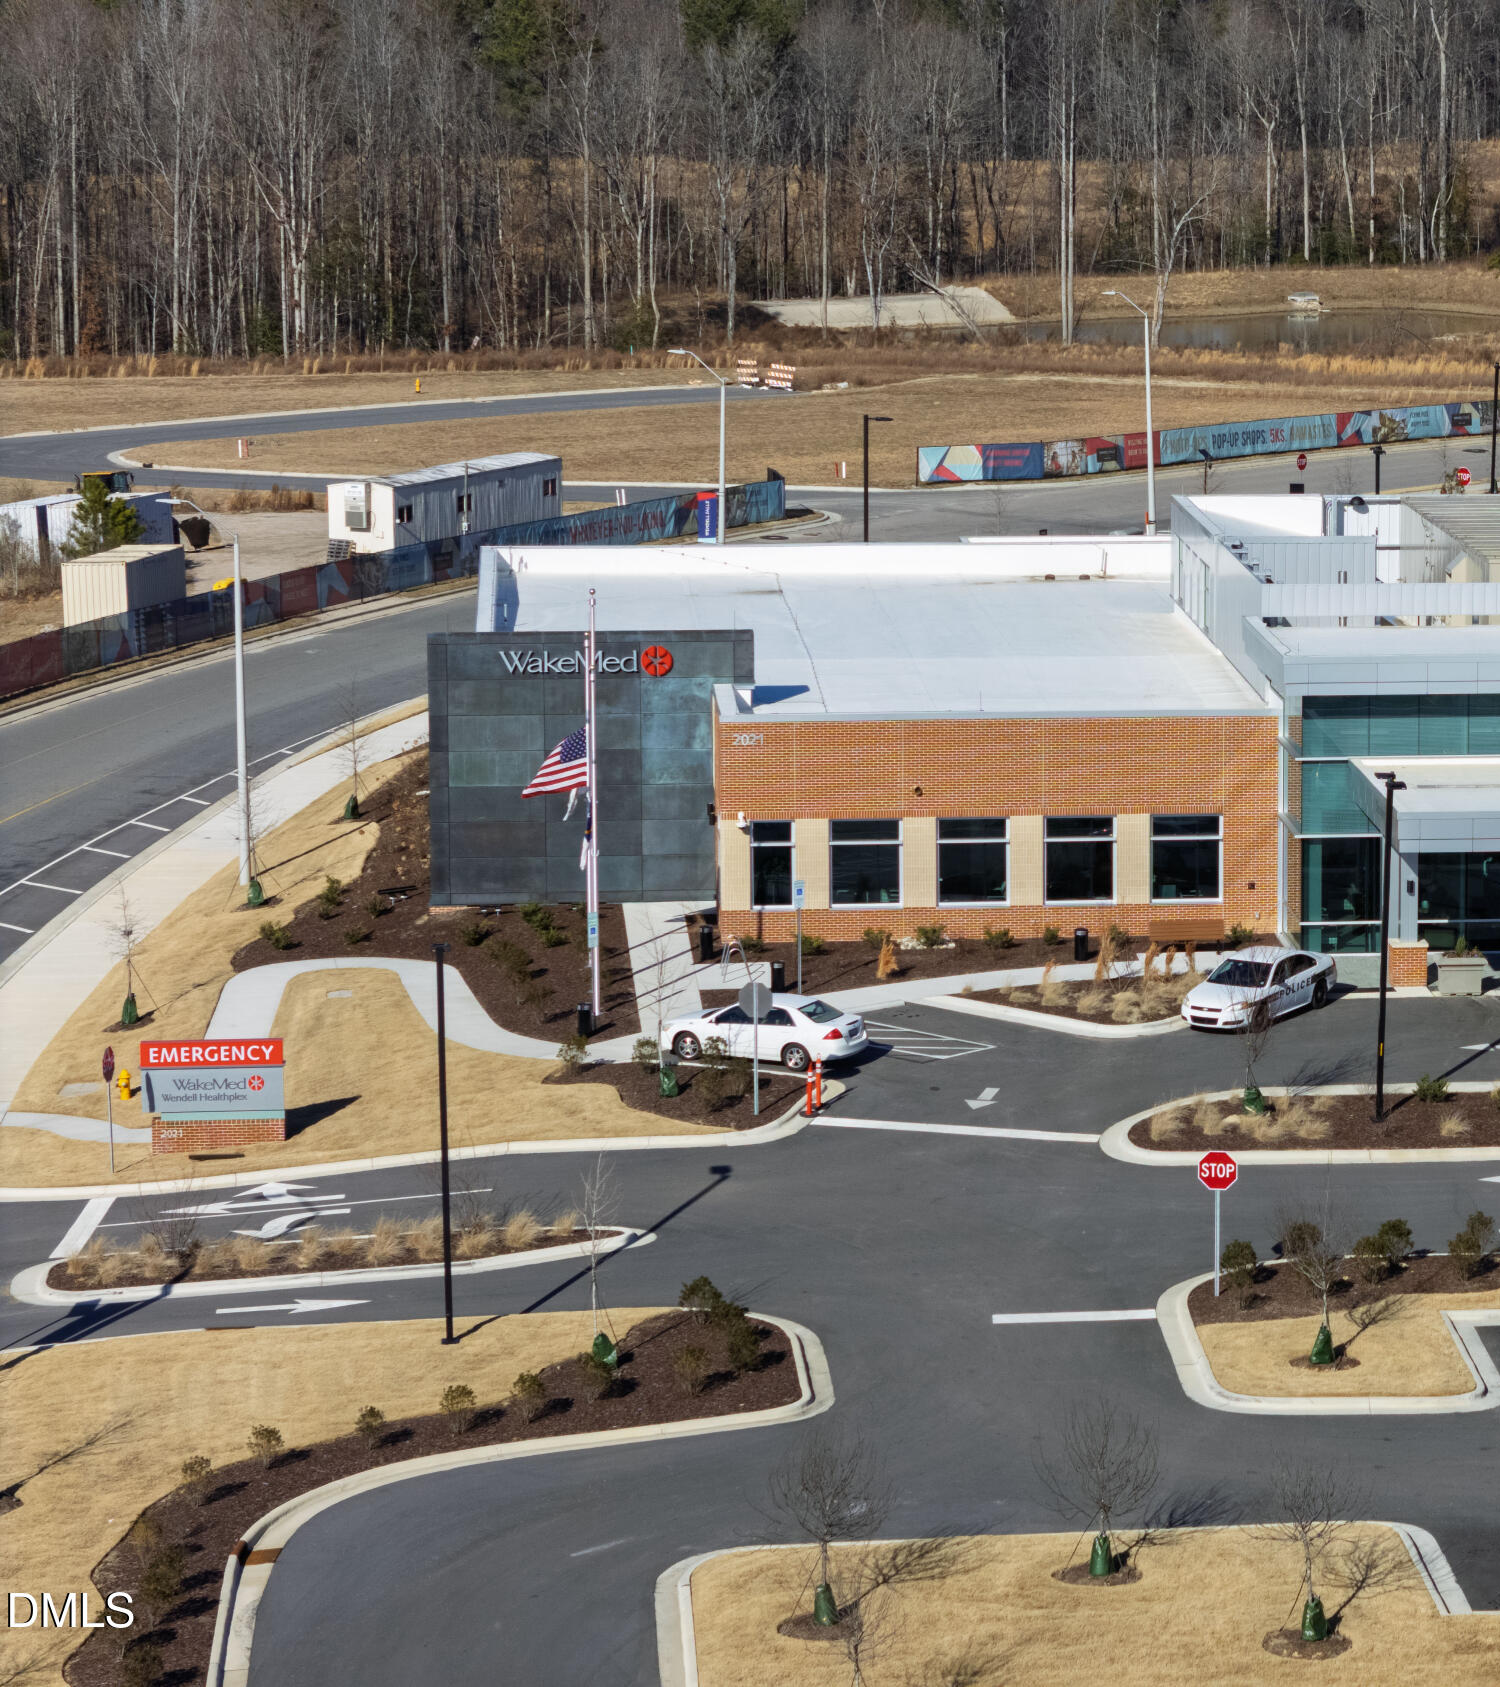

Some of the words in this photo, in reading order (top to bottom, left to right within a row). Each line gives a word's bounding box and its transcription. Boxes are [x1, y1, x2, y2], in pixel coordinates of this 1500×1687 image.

[1211, 431, 1240, 449] POP-UP
[1241, 428, 1267, 446] SHOPS.
[499, 650, 639, 674] WakeMed
[732, 733, 764, 746] 2021
[1279, 976, 1312, 998] POLICE
[149, 1045, 274, 1063] EMERGENCY
[172, 1078, 247, 1091] WakeMed
[162, 1093, 197, 1102] Wendell
[200, 1092, 248, 1103] Healthplex
[161, 1129, 183, 1138] 2021
[1201, 1163, 1235, 1178] STOP
